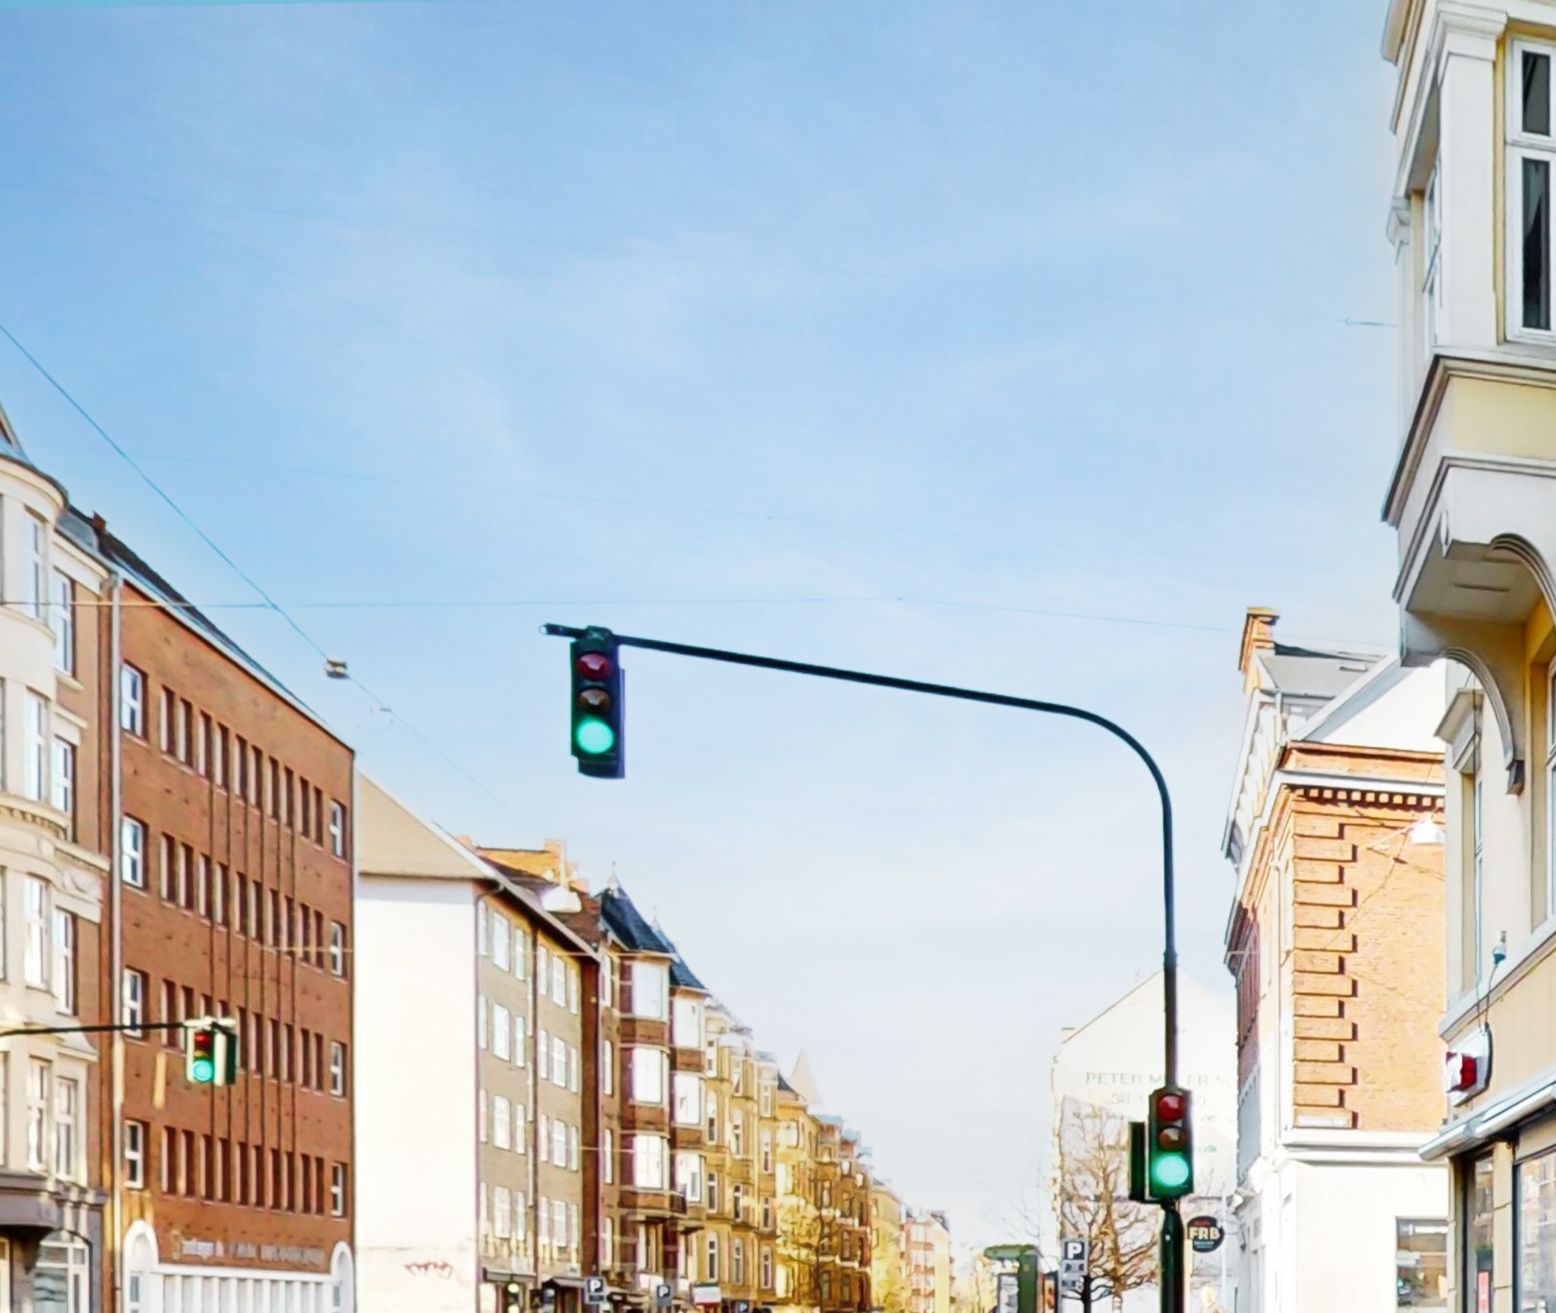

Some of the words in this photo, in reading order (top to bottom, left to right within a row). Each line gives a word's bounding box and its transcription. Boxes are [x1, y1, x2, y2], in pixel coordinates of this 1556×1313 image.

[1086, 1072, 1143, 1085] PETER
[1189, 1226, 1220, 1241] FRB
[1068, 1243, 1082, 1260] P
[590, 1279, 603, 1293] P
[659, 1287, 670, 1299] P
